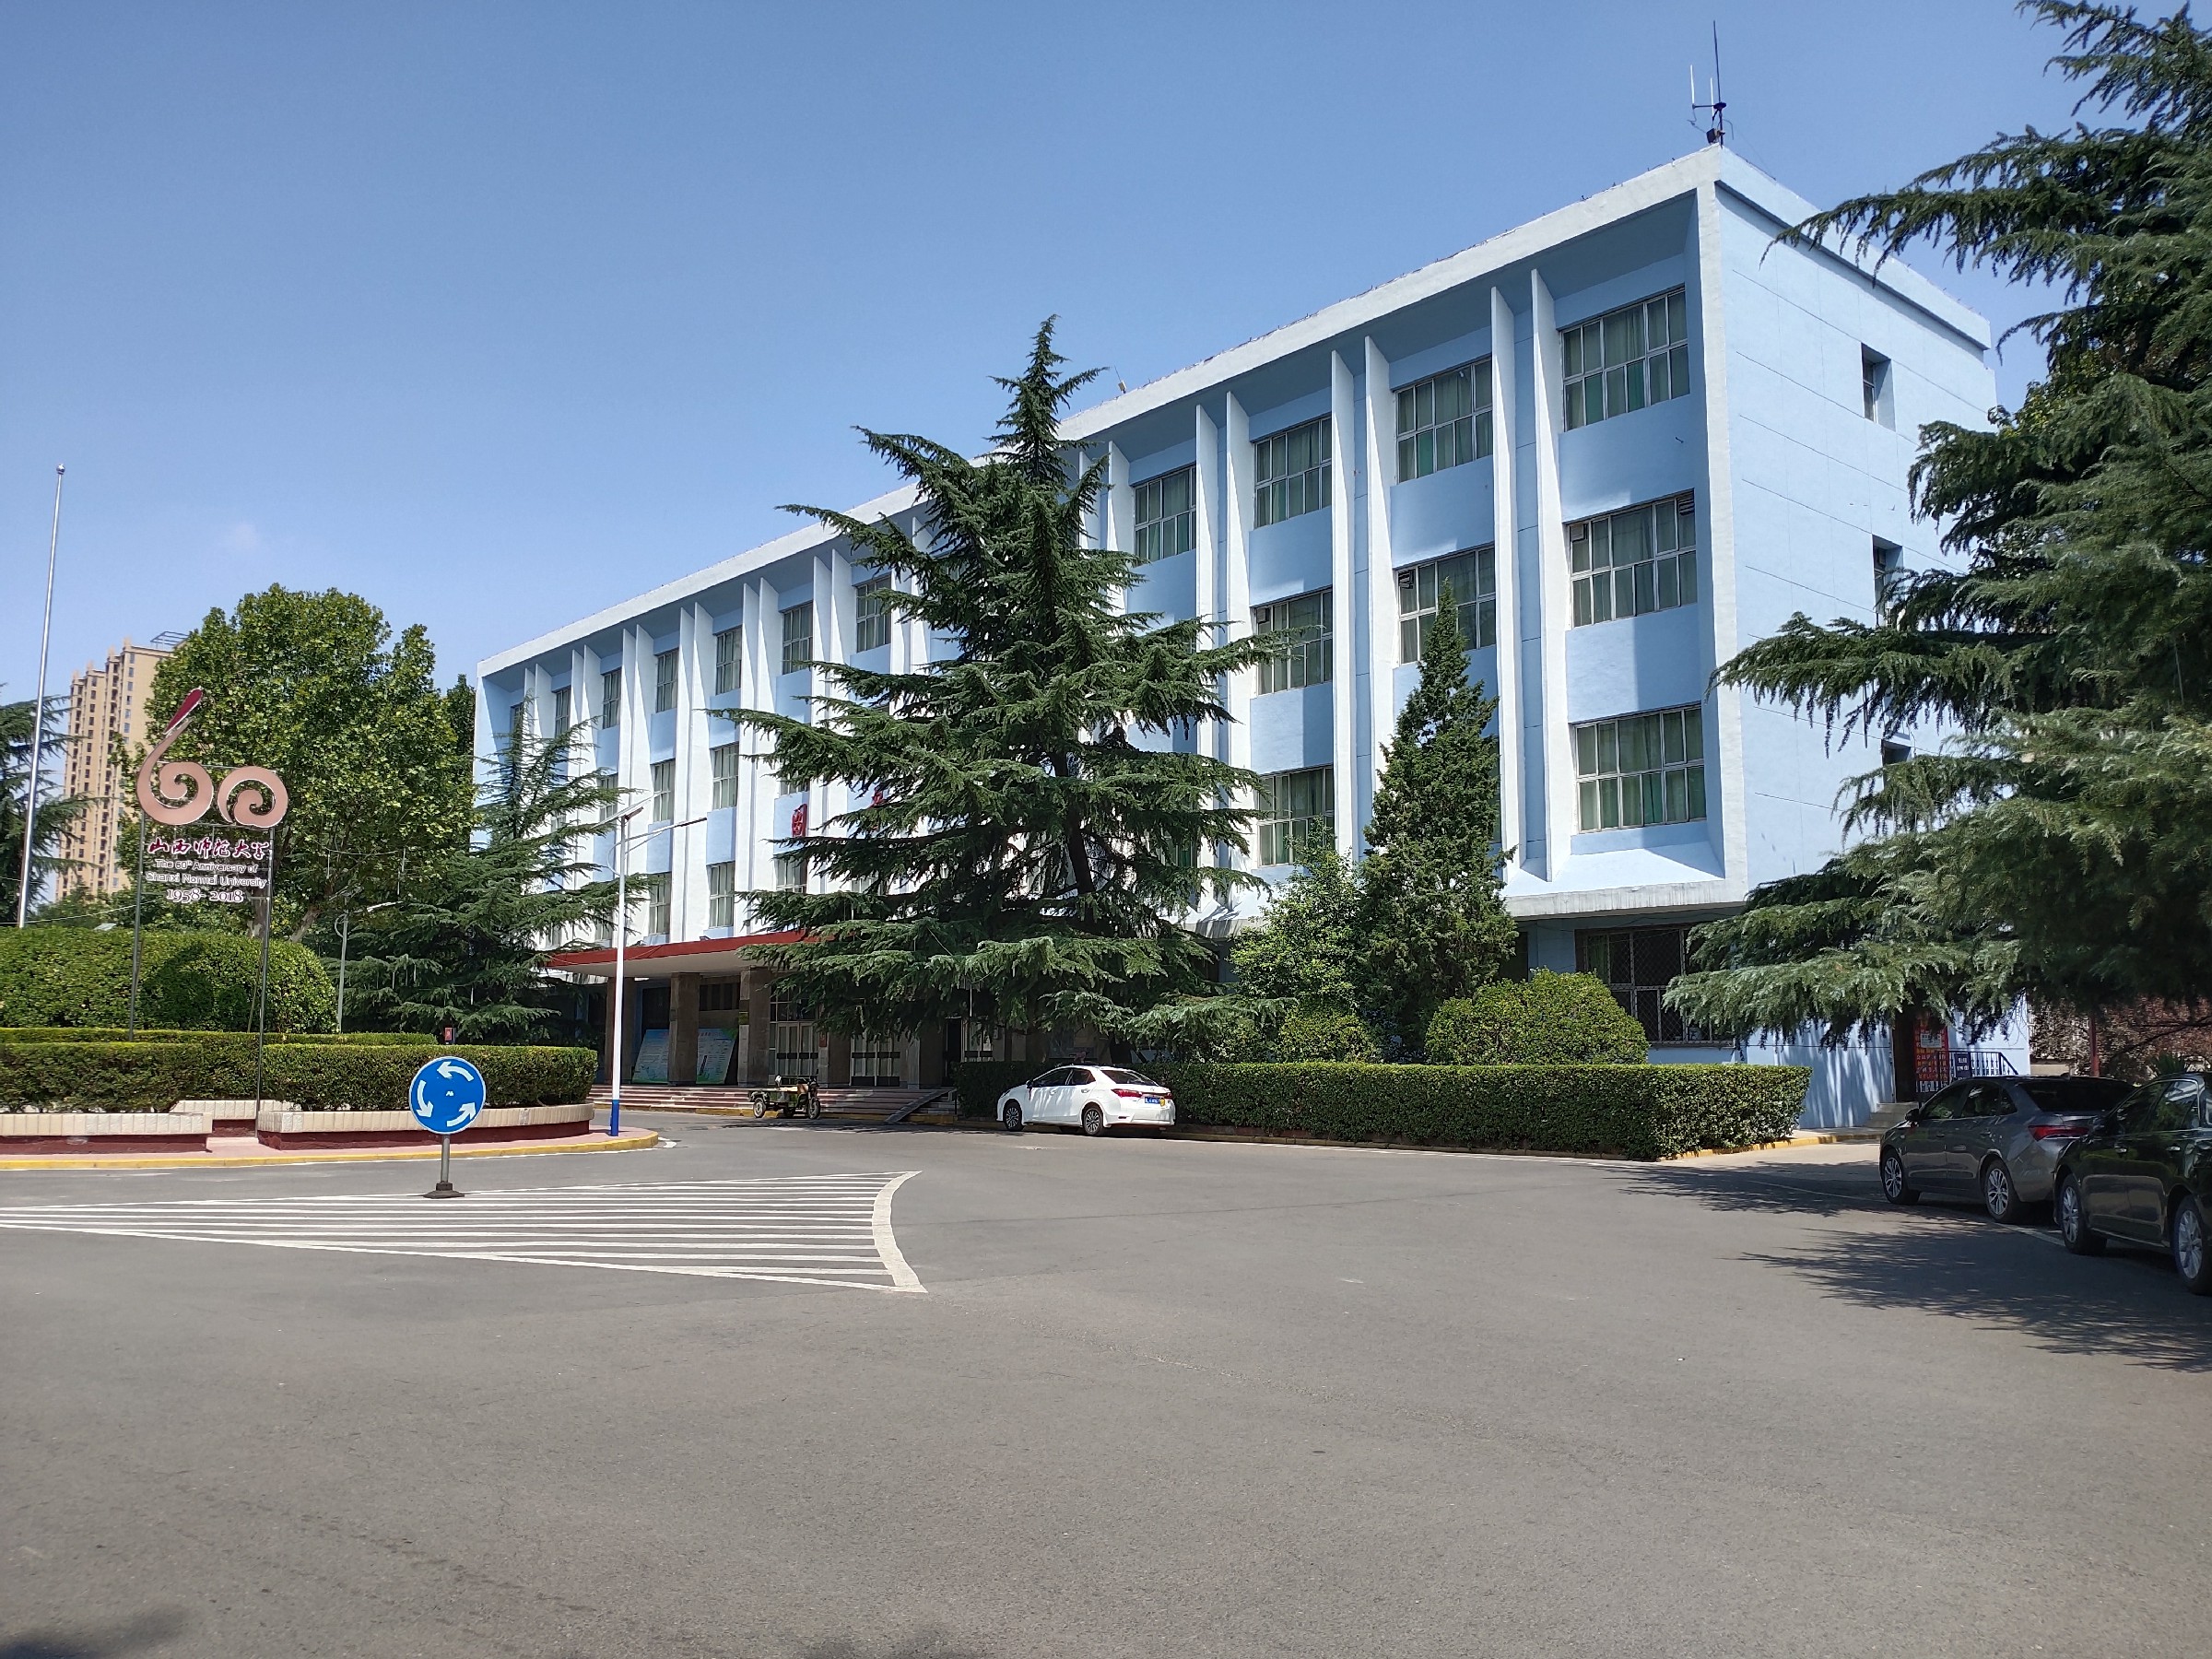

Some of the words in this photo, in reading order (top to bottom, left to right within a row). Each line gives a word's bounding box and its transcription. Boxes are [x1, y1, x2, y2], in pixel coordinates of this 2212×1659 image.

[147, 837, 270, 860] 山西师范大学
[155, 859, 173, 868] The
[193, 862, 246, 873] Anniversary
[247, 865, 259, 873] of
[146, 872, 180, 882] Shanxi
[182, 874, 218, 885] Normal
[220, 877, 268, 888] University
